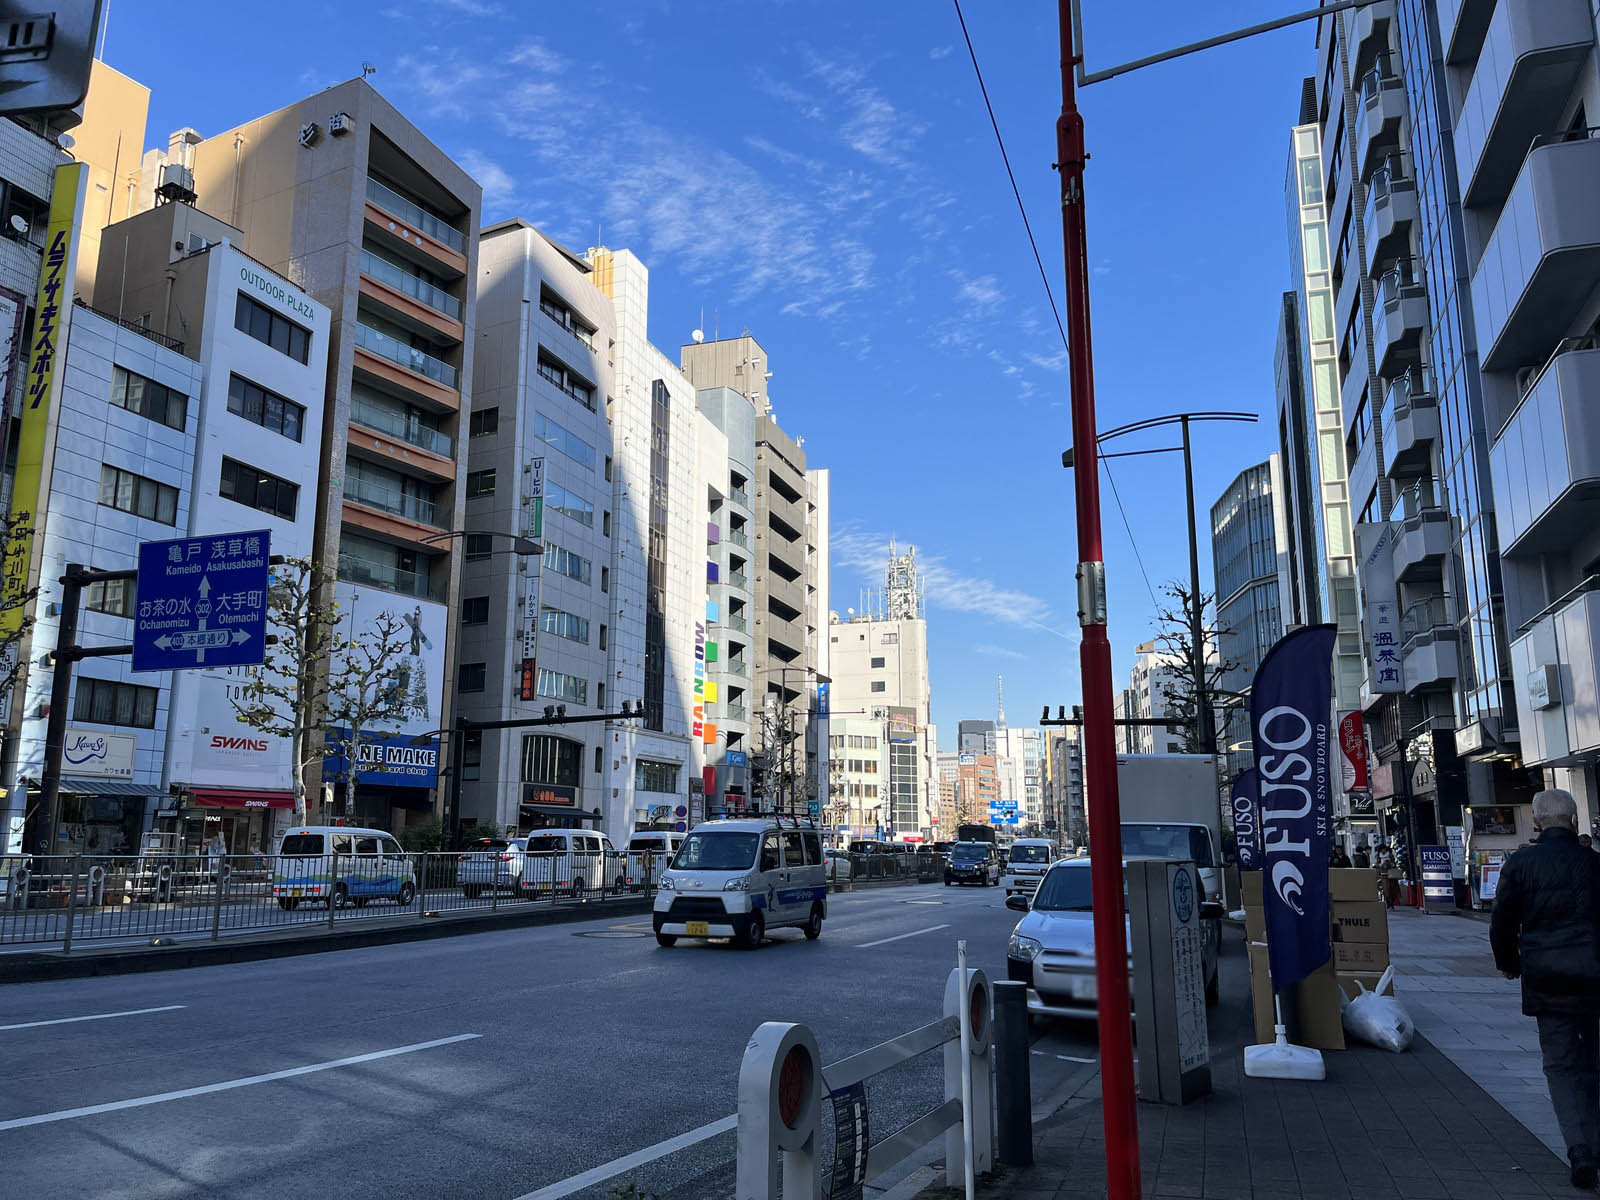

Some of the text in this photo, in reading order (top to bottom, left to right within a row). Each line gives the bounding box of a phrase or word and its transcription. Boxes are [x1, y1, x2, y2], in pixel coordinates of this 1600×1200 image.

[241, 268, 315, 321] OUTDOOR PLAZA
[30, 230, 67, 409] ムラサキスポーツ
[168, 536, 261, 563] 亀戸 浅草橋
[166, 557, 264, 576] Kameido Asakusabashi
[139, 590, 263, 618] お茶の水 302 大手町
[139, 611, 260, 631] Ochanomizu Otemachi
[171, 636, 184, 647] 403
[187, 632, 227, 646] 本郷通り
[692, 621, 705, 737] RAINBOW
[210, 736, 268, 751] SWANS
[386, 746, 437, 768] MAKE
[406, 766, 428, 776] shop
[1258, 705, 1313, 857] FUSO
[1315, 723, 1327, 837] SKI & SNOWBOARD
[1234, 796, 1254, 848] FUSO
[1422, 851, 1450, 861] FUSO
[1337, 917, 1370, 927] THULE
